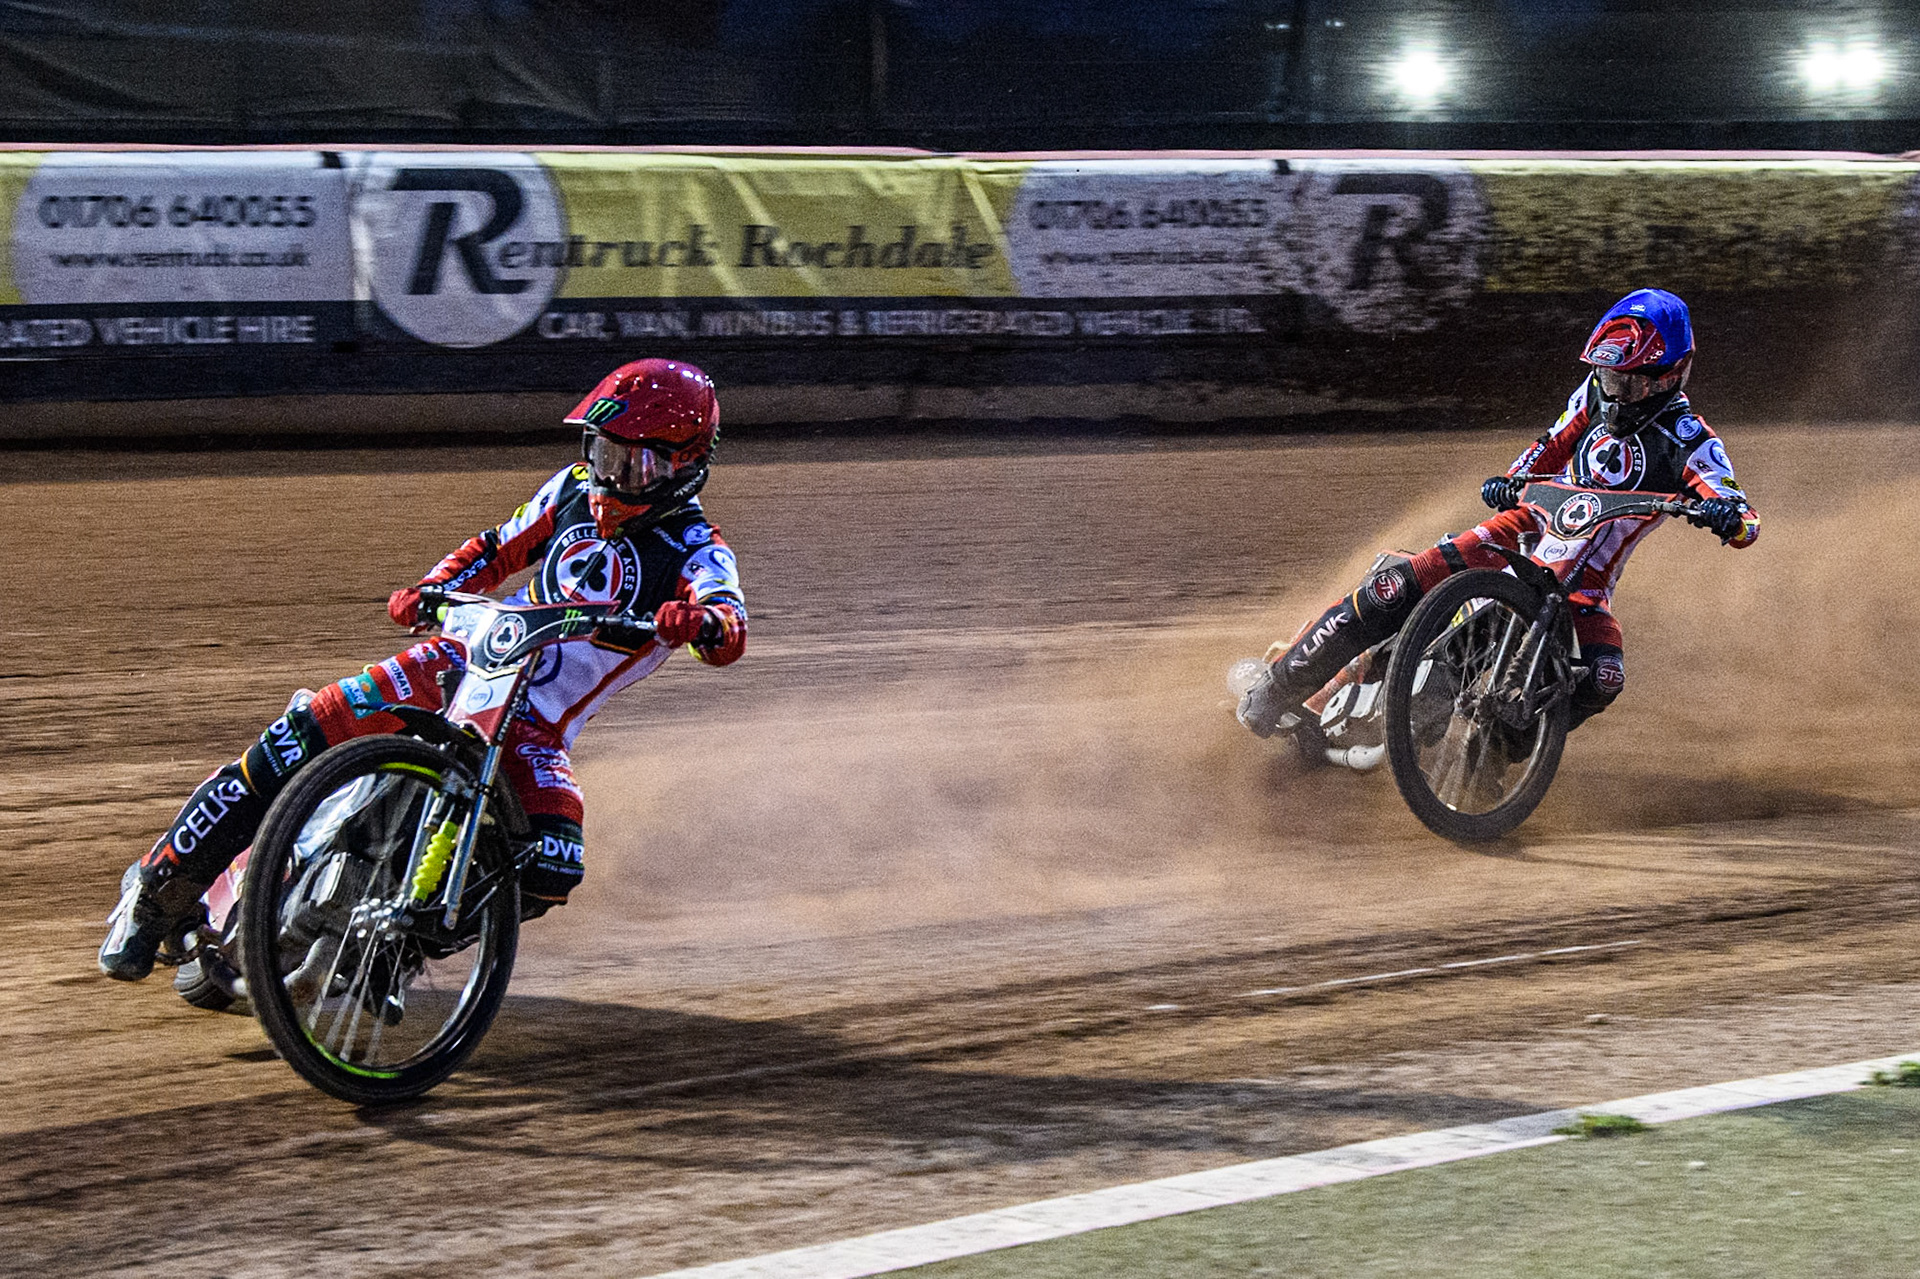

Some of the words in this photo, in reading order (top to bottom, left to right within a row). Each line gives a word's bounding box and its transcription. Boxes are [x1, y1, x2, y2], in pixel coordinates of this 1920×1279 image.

[739, 223, 997, 269] Rochdale
[95, 316, 234, 346] VEHICLE
[1631, 445, 1643, 473] ACES
[561, 528, 598, 548] BELLE
[622, 556, 637, 592] ACES
[1378, 575, 1396, 601] STS
[1302, 611, 1349, 657] LINK
[1599, 667, 1624, 683] STS
[268, 715, 304, 767] DVR
